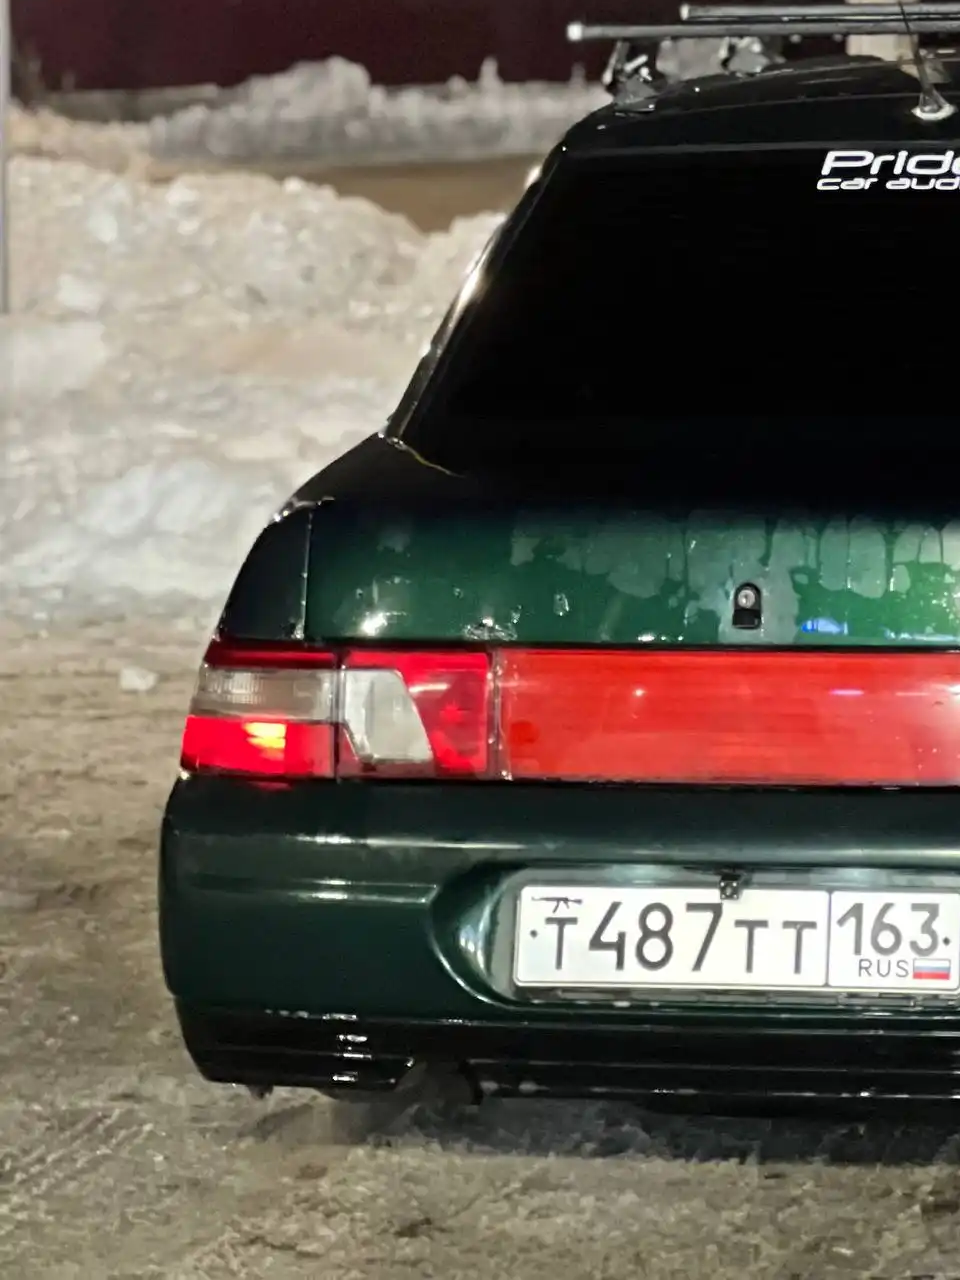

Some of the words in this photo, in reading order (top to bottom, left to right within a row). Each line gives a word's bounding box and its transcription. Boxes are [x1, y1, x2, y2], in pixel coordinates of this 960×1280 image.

[816, 177, 878, 190] car
[837, 902, 940, 957] 163
[858, 959, 910, 978] RUS
